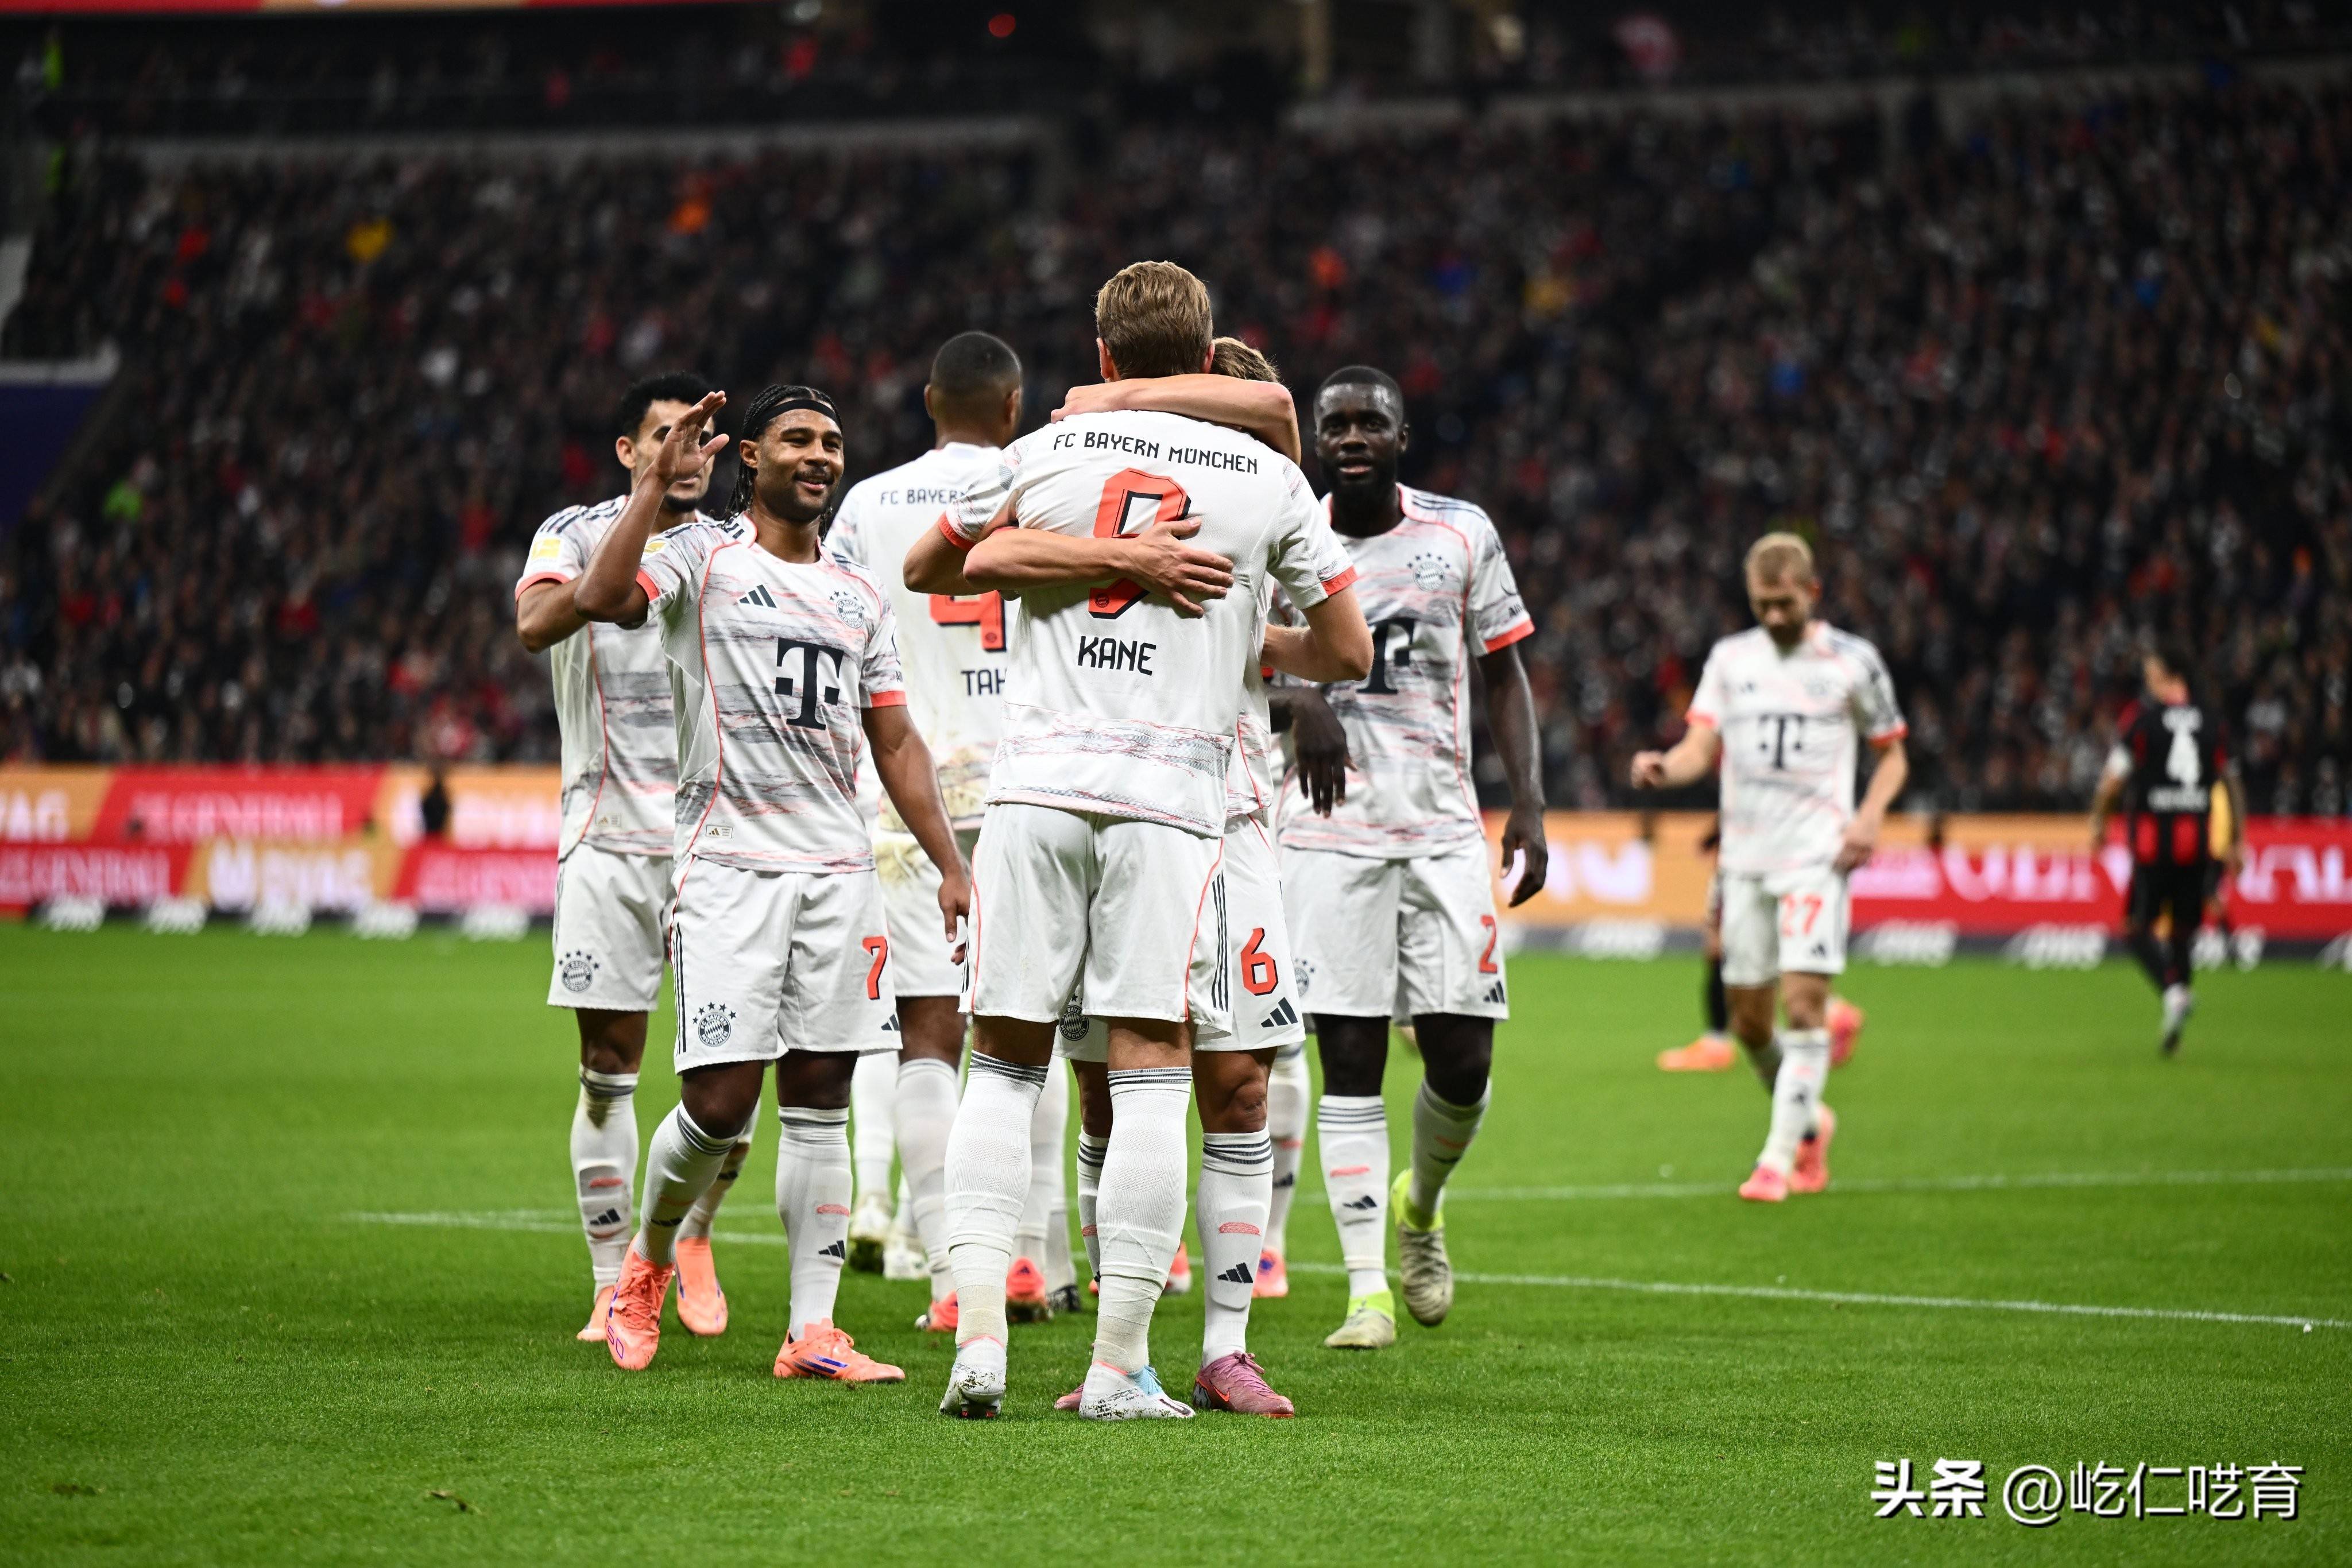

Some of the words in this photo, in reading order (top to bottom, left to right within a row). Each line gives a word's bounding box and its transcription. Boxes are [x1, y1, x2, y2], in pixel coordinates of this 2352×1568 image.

[1053, 432, 1074, 451] FC
[1084, 432, 1159, 459] BAYERN
[1168, 446, 1258, 475] MÜNCHEN
[881, 490, 898, 505] FC
[907, 489, 966, 504] BAYER
[1077, 636, 1156, 676] KANE
[1781, 894, 1823, 936] 27
[1240, 927, 1279, 996] 6
[1478, 915, 1498, 974] 2
[862, 936, 888, 1000] 7
